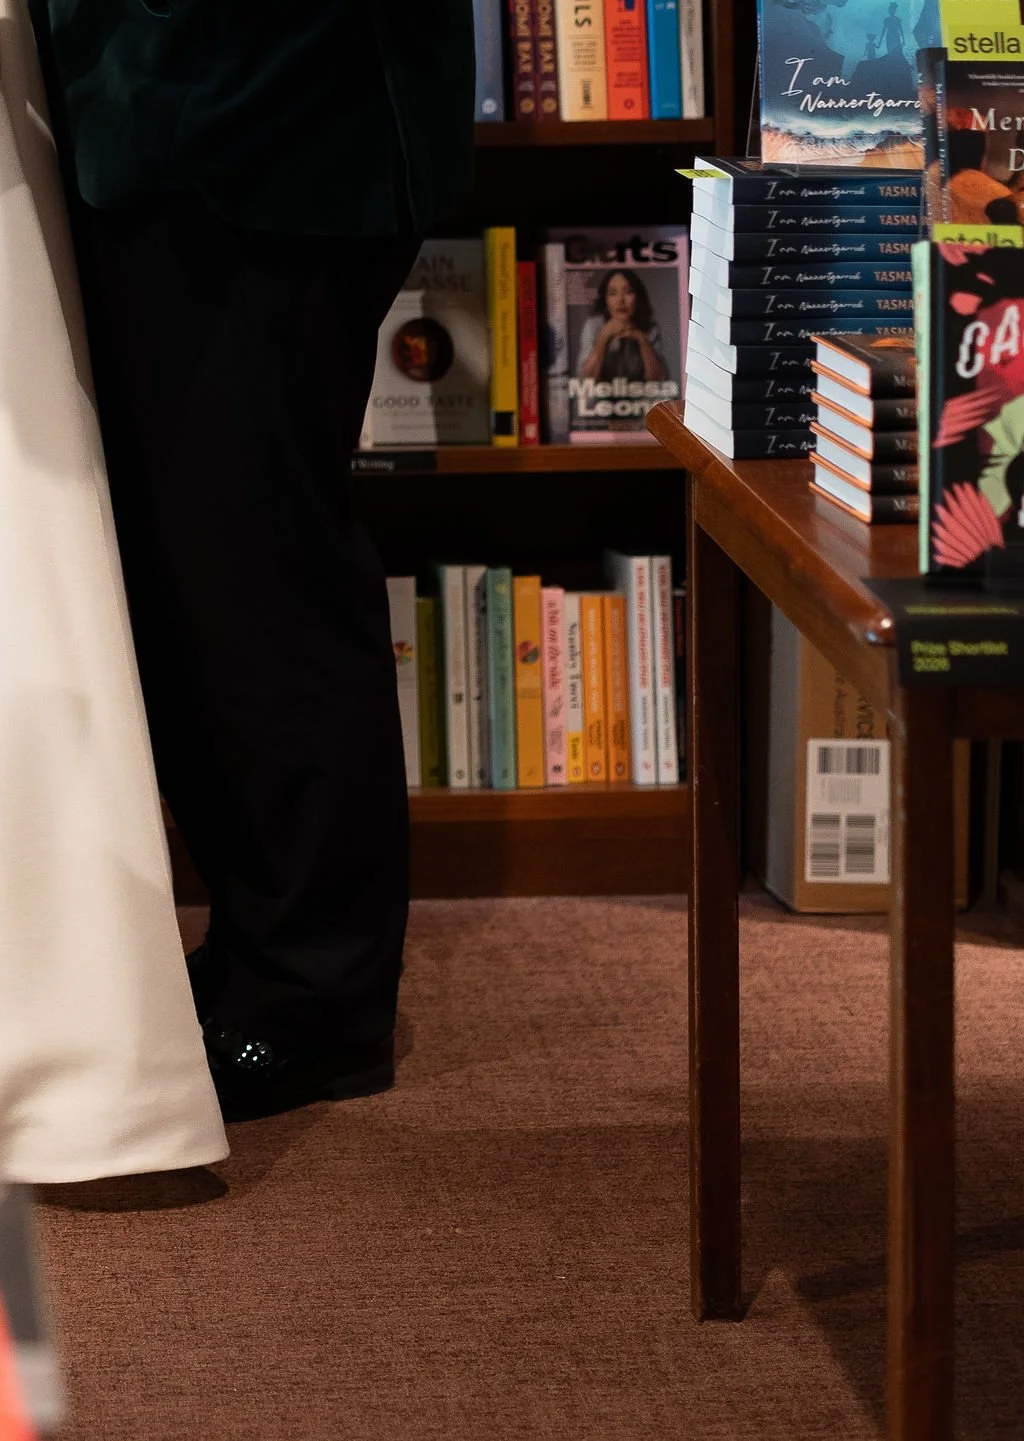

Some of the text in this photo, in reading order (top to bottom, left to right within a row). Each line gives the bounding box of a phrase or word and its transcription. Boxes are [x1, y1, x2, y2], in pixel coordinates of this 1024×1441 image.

[953, 31, 1022, 54] stella
[519, 42, 533, 74] BAR
[541, 42, 555, 74] BAR
[780, 56, 852, 98] I am
[765, 180, 917, 200] I am TASMA
[765, 209, 777, 229] I
[878, 214, 917, 225] TASMA
[766, 238, 778, 257] I
[567, 378, 678, 399] Melissa
